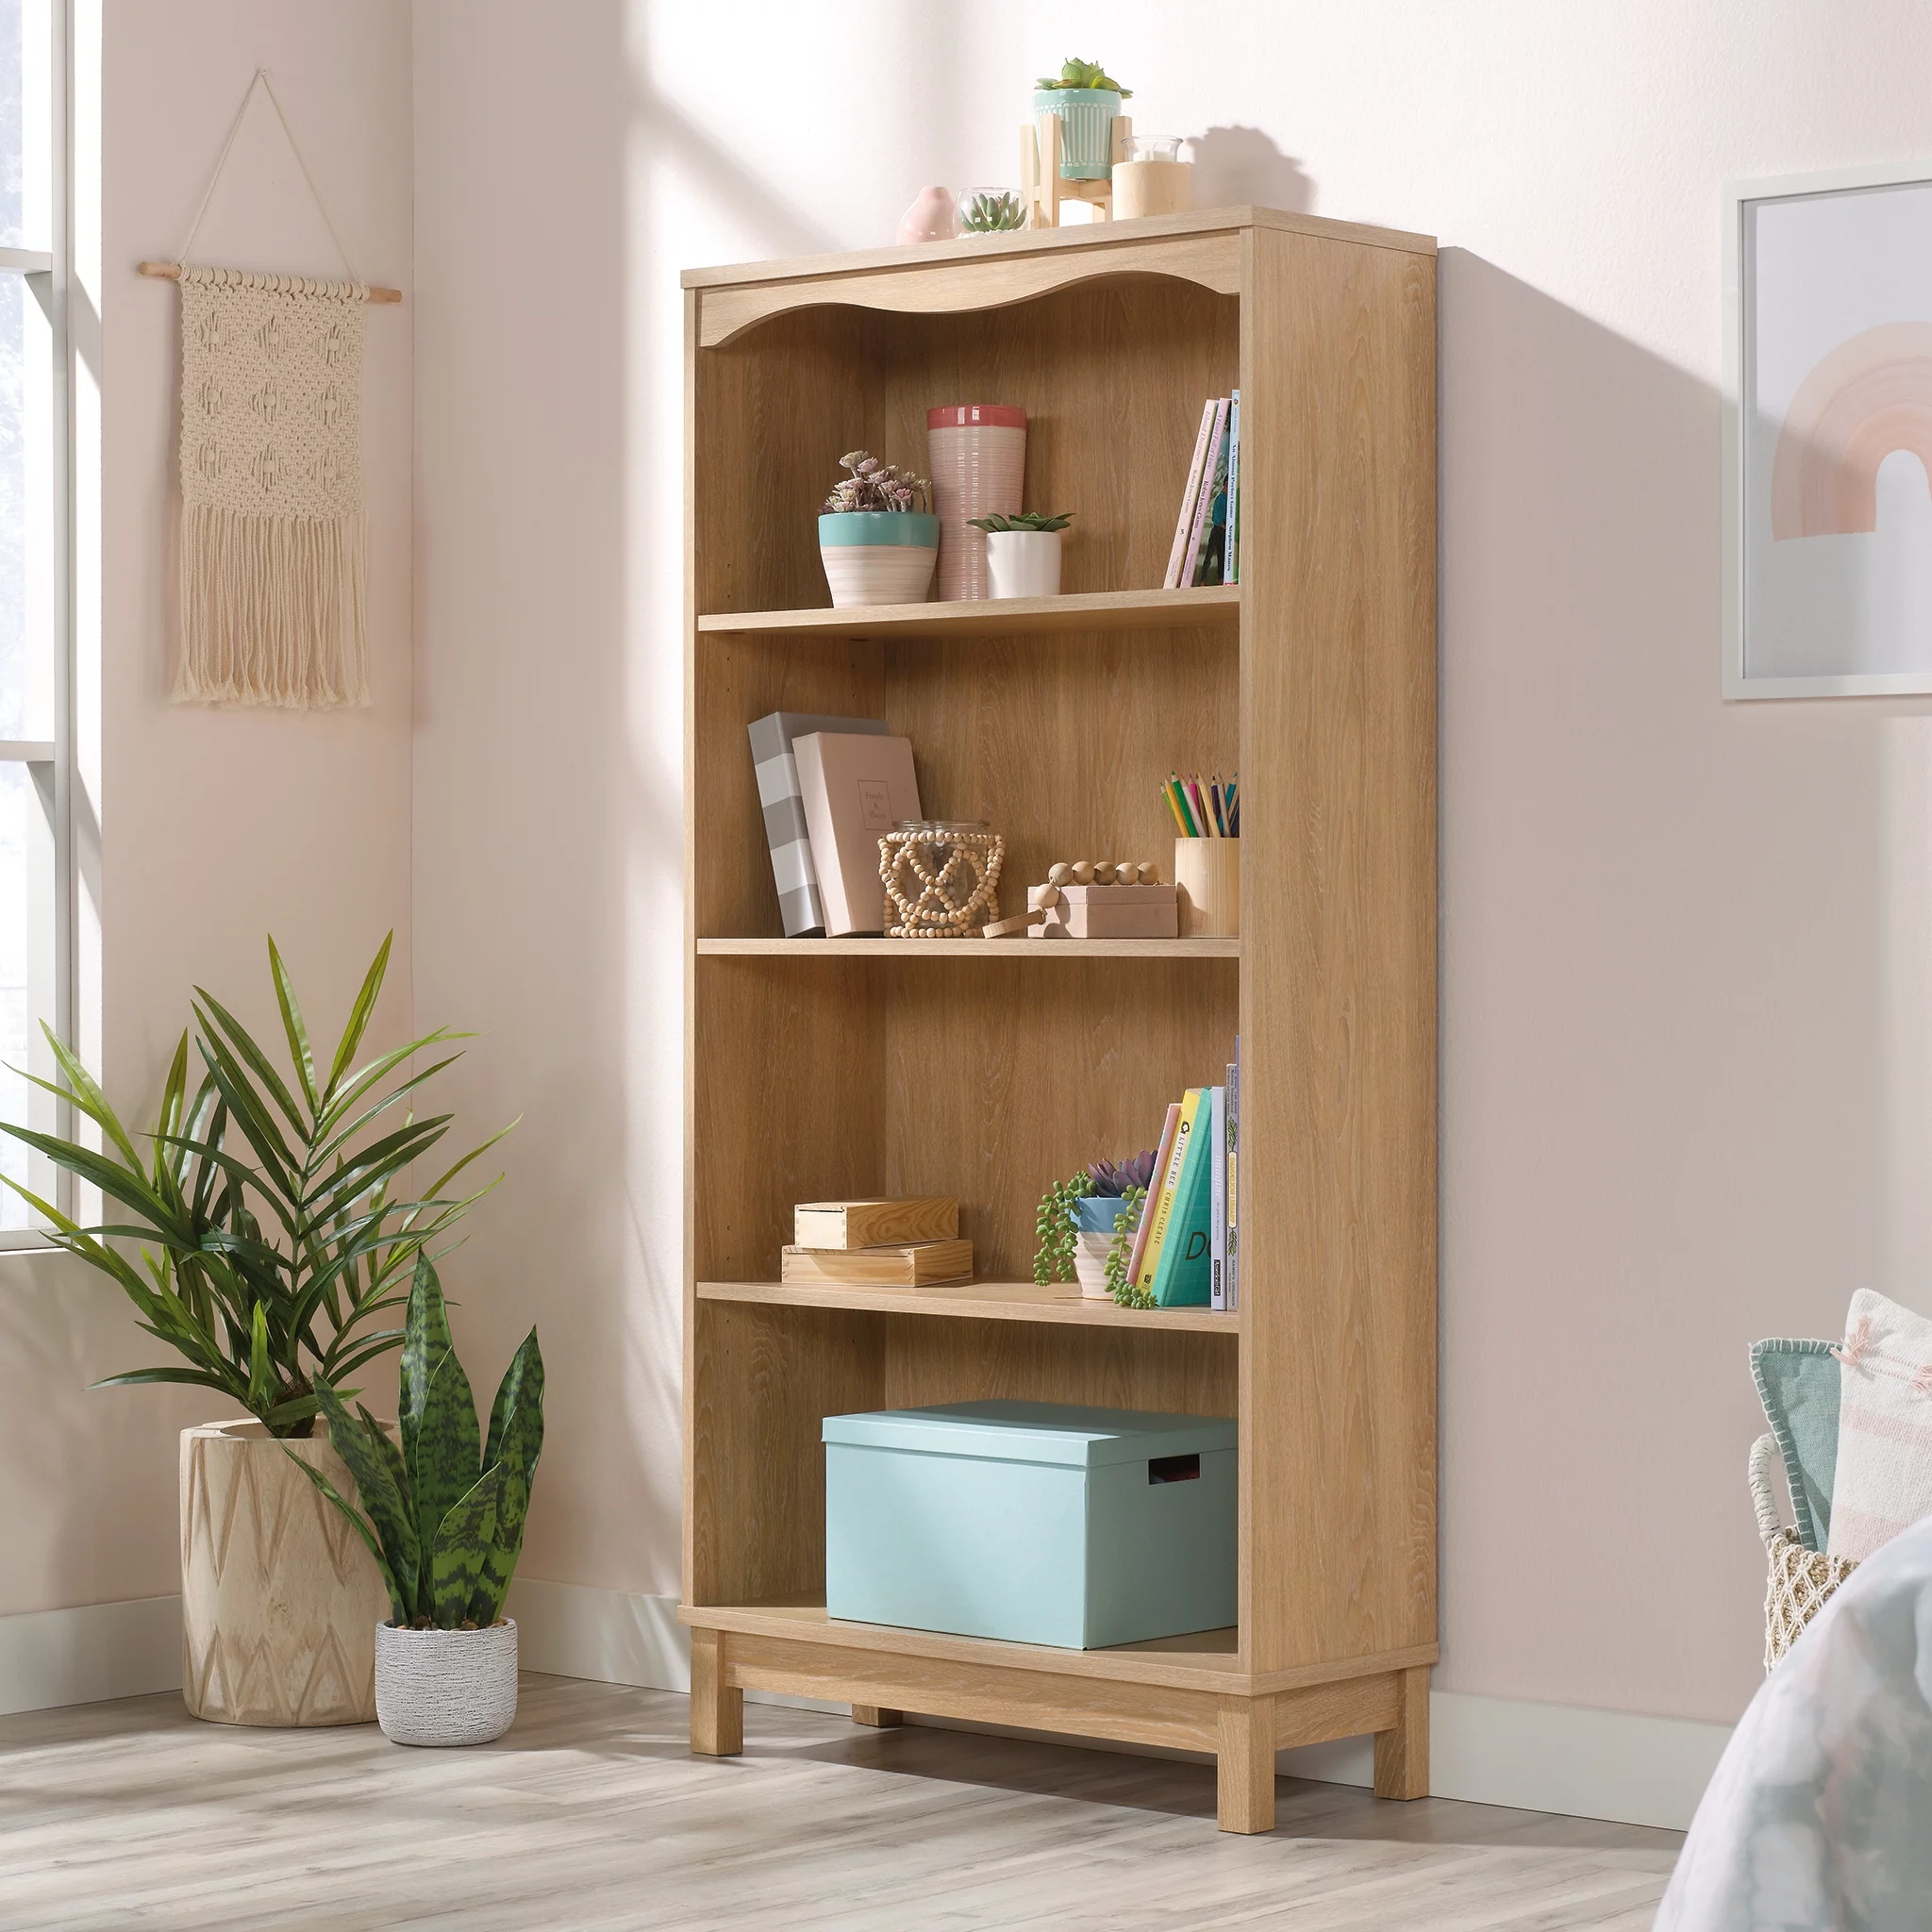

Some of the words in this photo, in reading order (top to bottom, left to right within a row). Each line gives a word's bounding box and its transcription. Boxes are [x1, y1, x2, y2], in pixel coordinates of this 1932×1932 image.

[1173, 1136, 1186, 1167] LITTLE
[1168, 1170, 1177, 1186] BEE
[1213, 1155, 1222, 1199] imagine
[1161, 1191, 1172, 1215] CHRIS
[1154, 1216, 1166, 1245] CLEAVE
[1186, 1231, 1211, 1260] D
